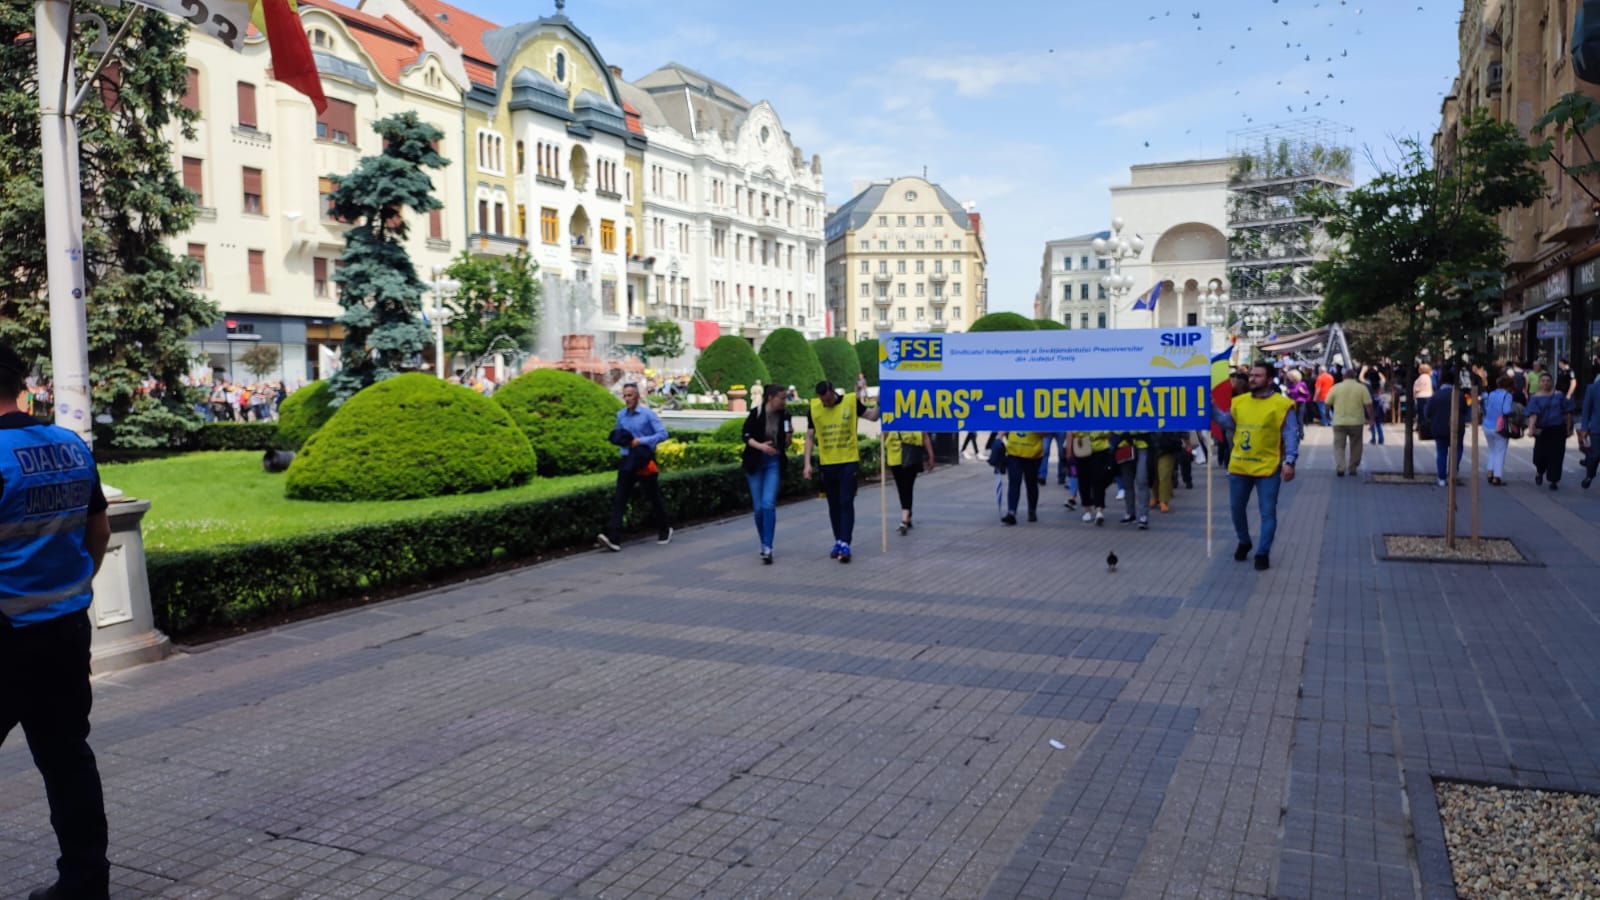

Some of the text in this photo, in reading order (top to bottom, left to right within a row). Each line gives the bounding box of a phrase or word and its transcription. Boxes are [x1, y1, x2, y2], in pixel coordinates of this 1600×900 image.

[901, 339, 942, 358] FSE
[1160, 332, 1202, 347] SIIP
[1034, 379, 1187, 429] DEMNITĂȚII
[16, 443, 85, 473] DIALOG
